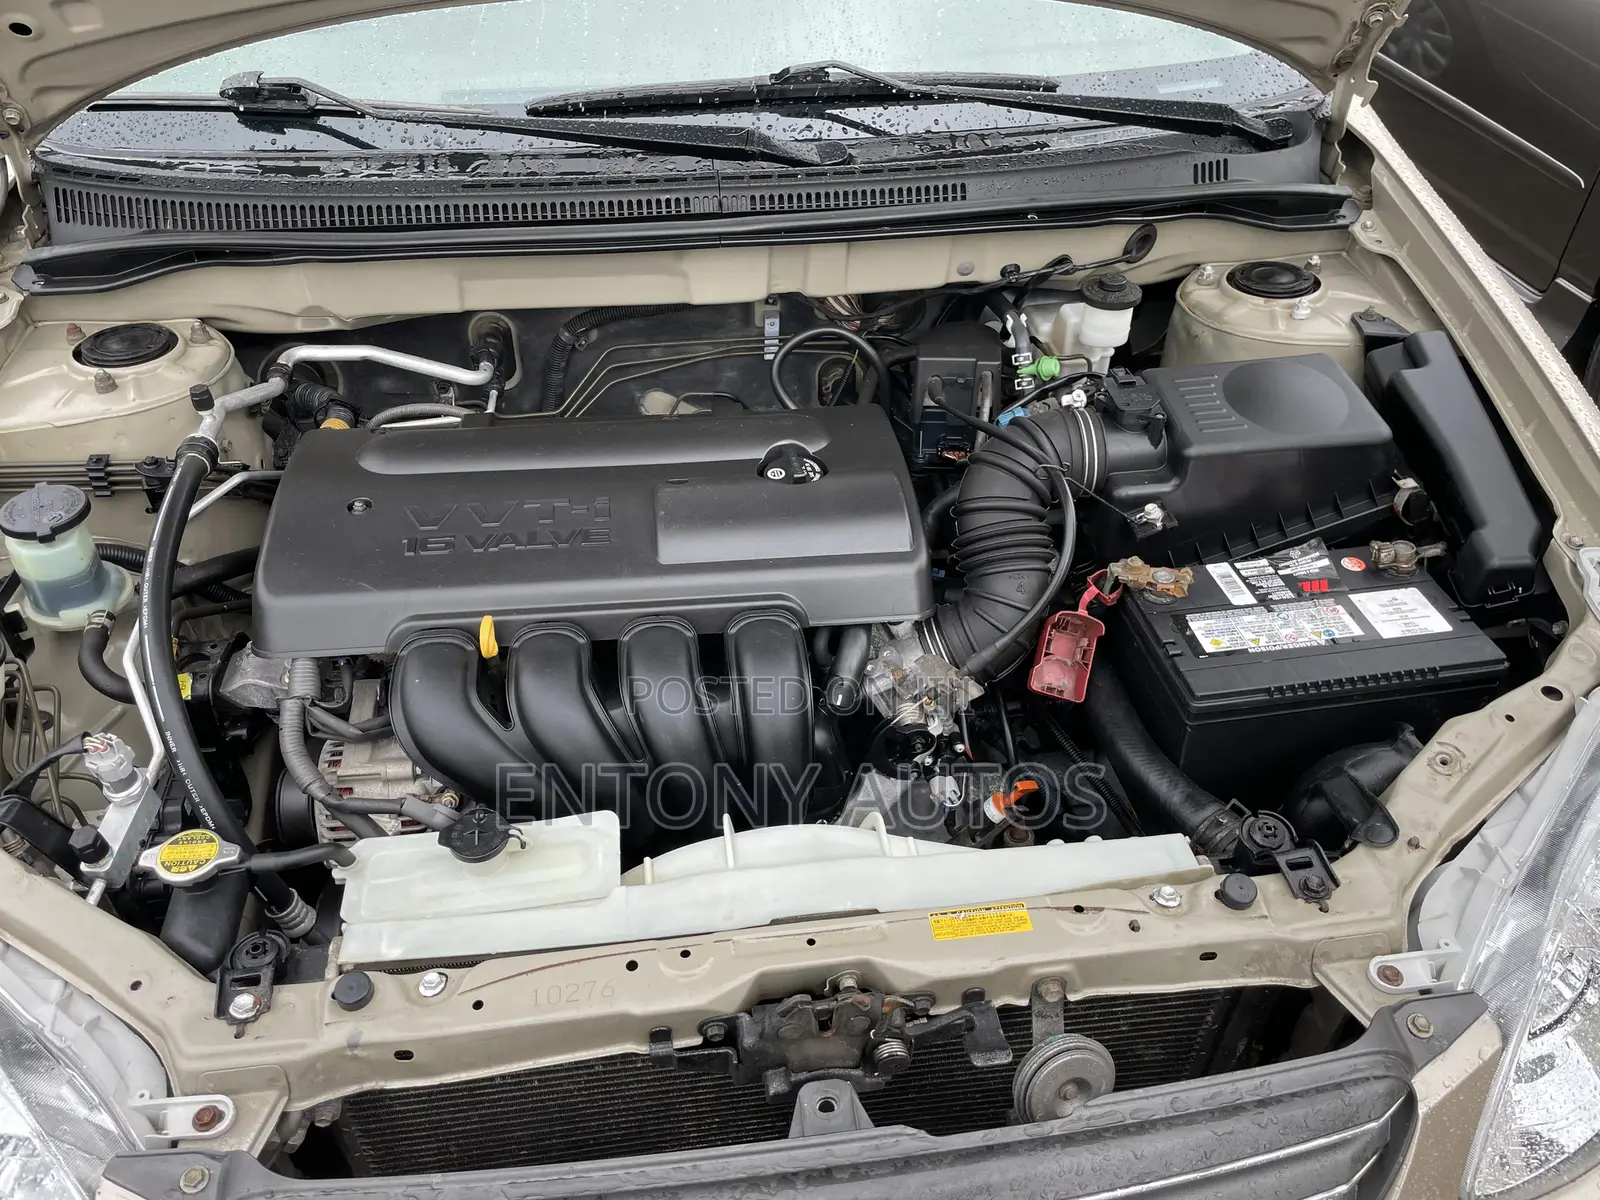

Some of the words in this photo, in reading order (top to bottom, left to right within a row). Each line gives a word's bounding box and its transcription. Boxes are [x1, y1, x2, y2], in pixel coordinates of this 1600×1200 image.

[403, 496, 611, 531] VVT-i
[402, 534, 456, 556] 16
[463, 527, 611, 552] VALVE
[165, 730, 177, 753] INNER
[185, 778, 200, 803] OUTER
[531, 979, 615, 1007] 10276
